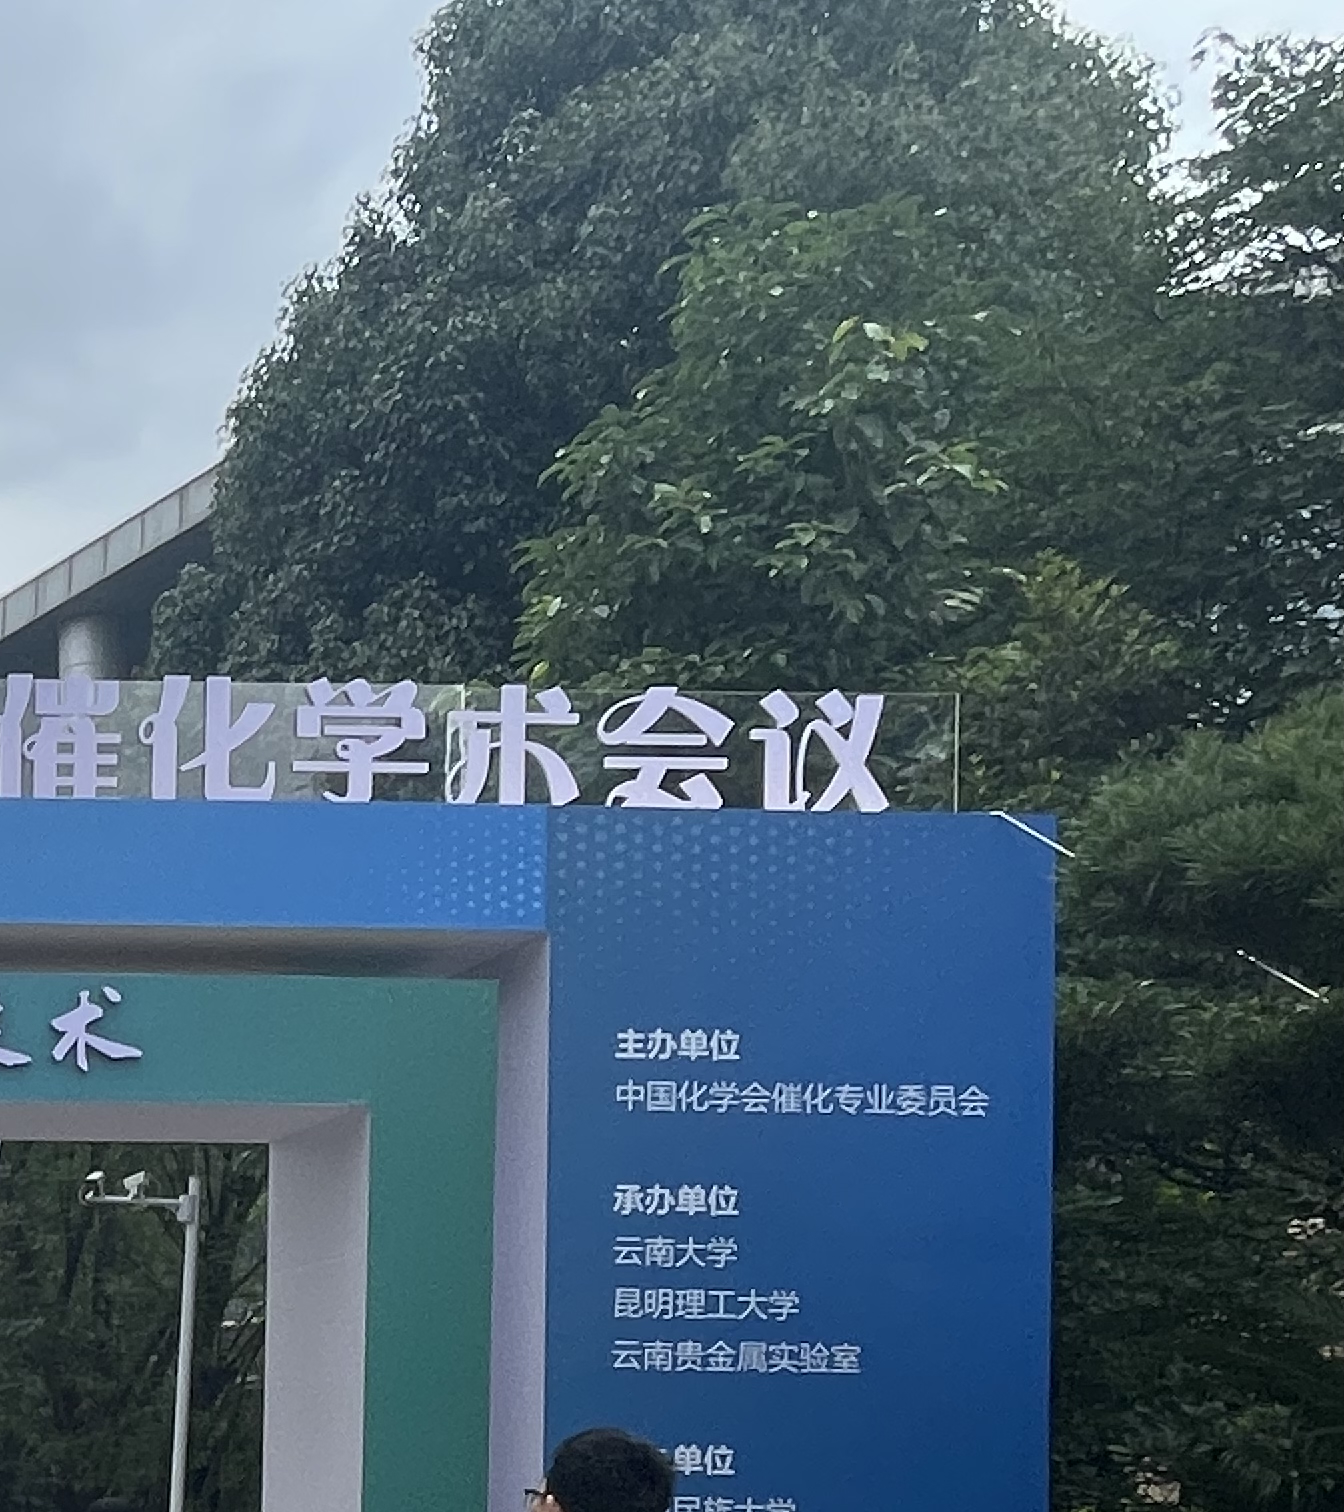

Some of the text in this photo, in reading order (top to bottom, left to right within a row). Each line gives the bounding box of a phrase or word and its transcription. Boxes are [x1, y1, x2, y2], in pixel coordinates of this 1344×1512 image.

[614, 1028, 741, 1061] 主办单位
[615, 1079, 990, 1118] 中国化学会催化专业委员会
[612, 1184, 740, 1217] 承办单位
[612, 1235, 739, 1269] 云南大学
[613, 1289, 801, 1323] 昆明理工大学
[611, 1340, 863, 1375] 云南贵金属实验室
[659, 1444, 737, 1477] 单位
